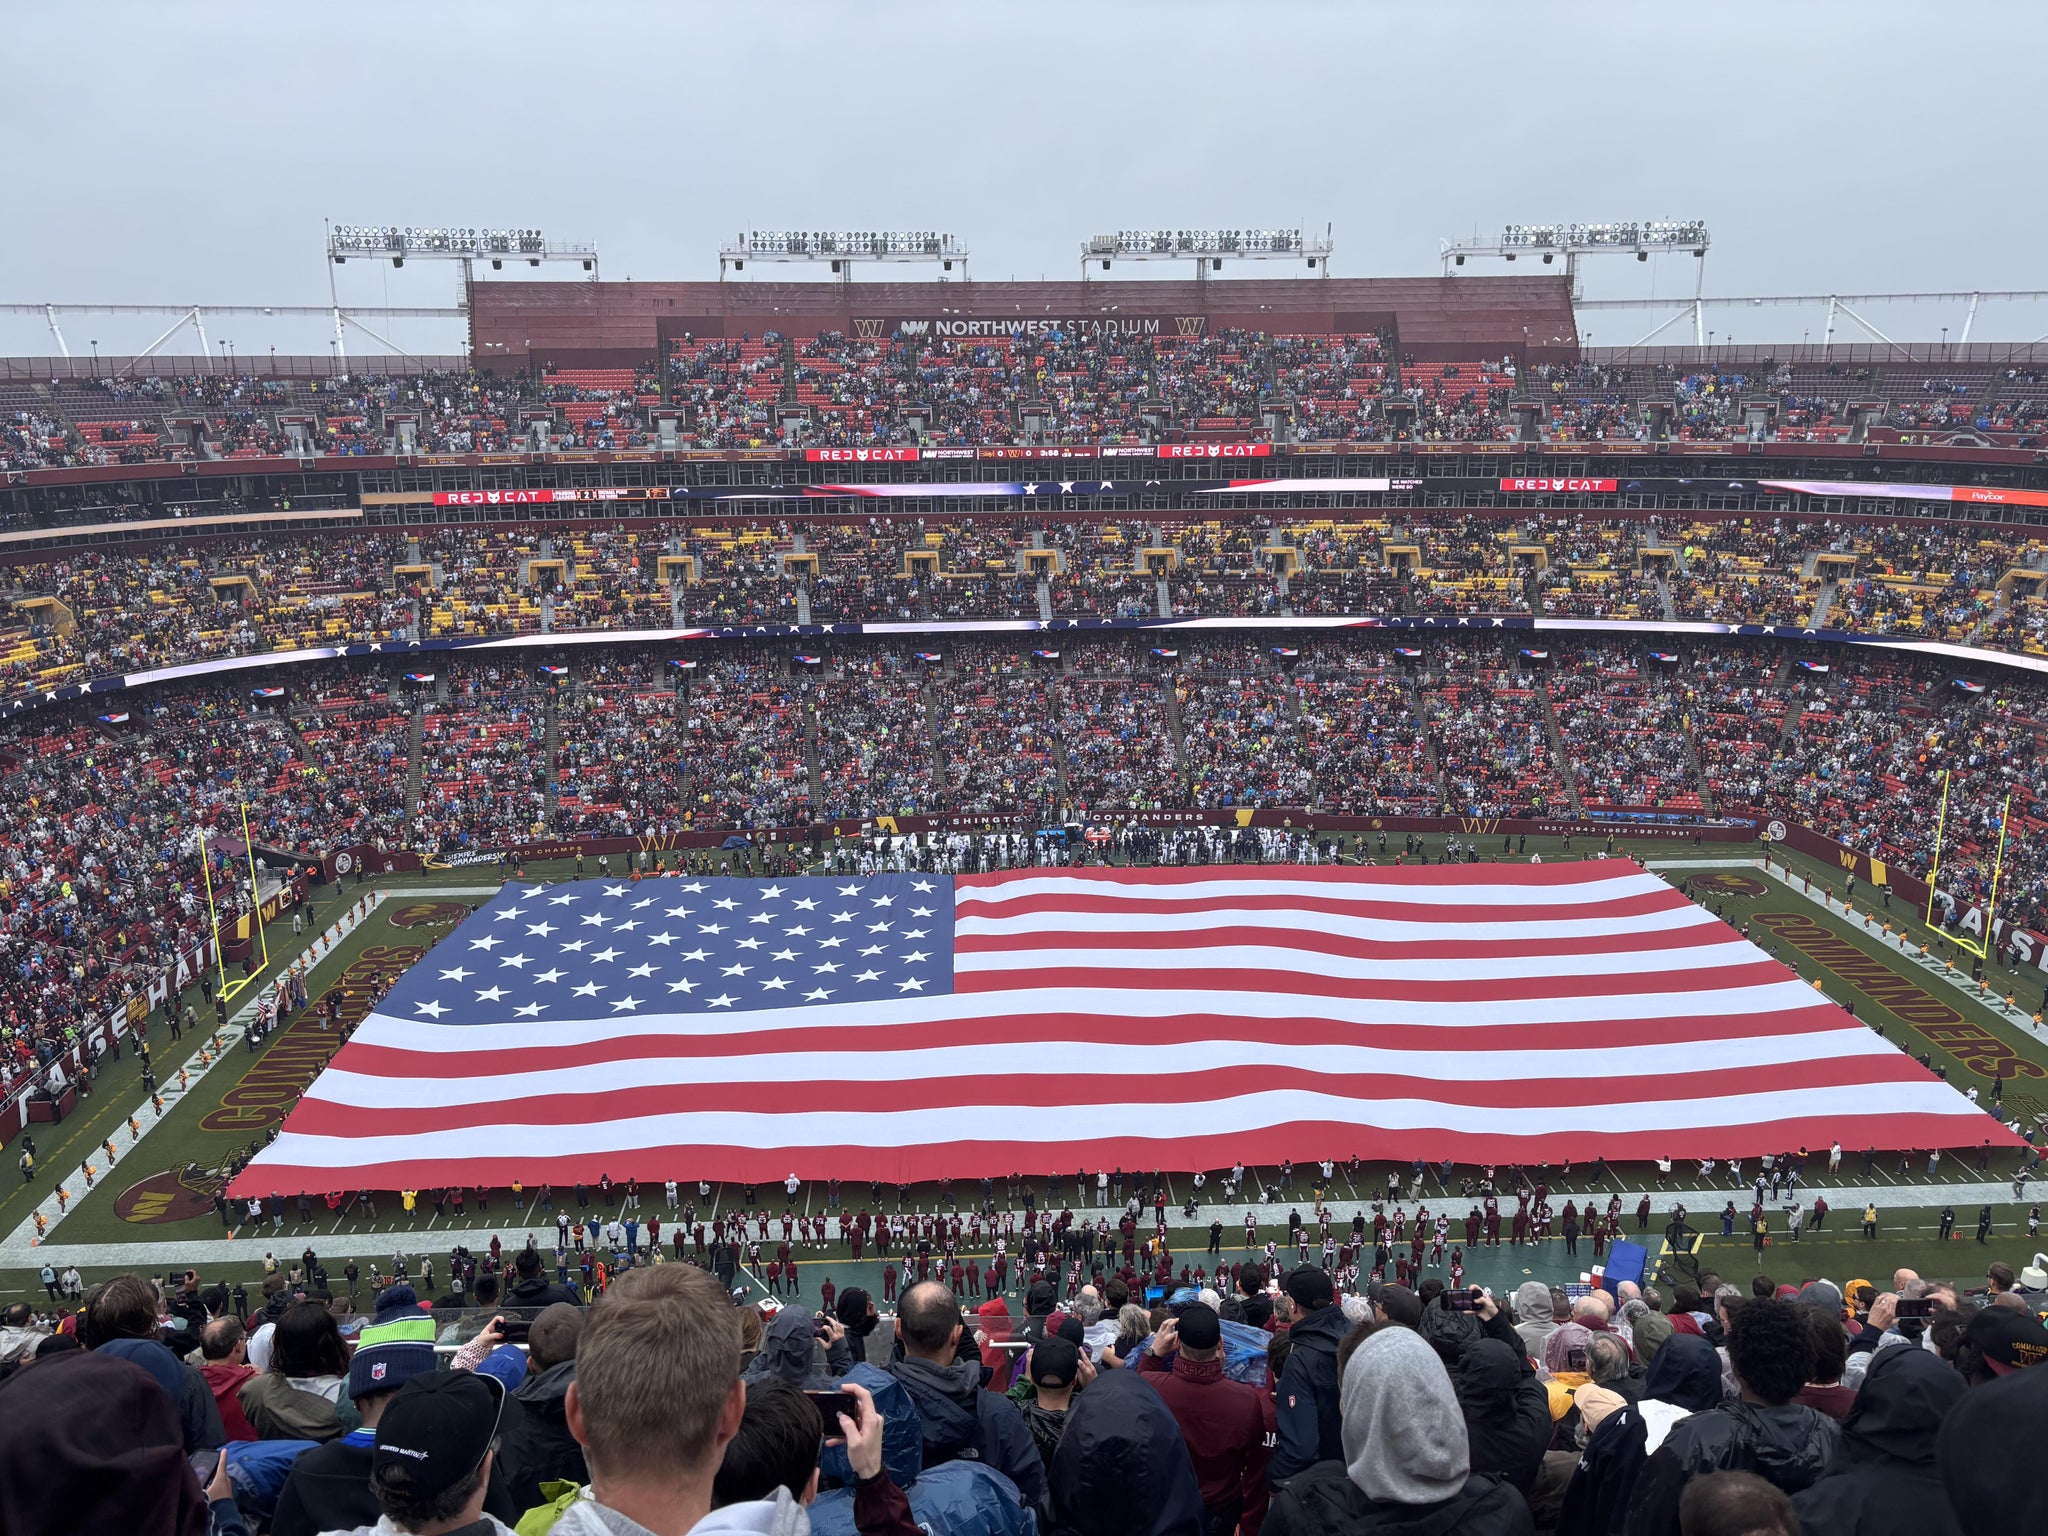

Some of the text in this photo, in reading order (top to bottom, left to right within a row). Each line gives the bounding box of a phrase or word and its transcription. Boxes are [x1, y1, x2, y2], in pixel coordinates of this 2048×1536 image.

[936, 320, 1061, 335] NORTHWEST
[1067, 319, 1160, 334] STADIUM
[820, 450, 904, 460] RED CAT
[1172, 446, 1256, 456] RED CAT
[1515, 480, 1602, 489] RED CAT
[448, 492, 538, 503] RED CAT
[1972, 492, 2005, 500] Paycor
[928, 816, 1035, 826] WSHINGTO
[537, 845, 582, 854] CHAMPS
[1751, 912, 2048, 1080] COMMANDERS
[400, 1449, 421, 1459] MARTIN
